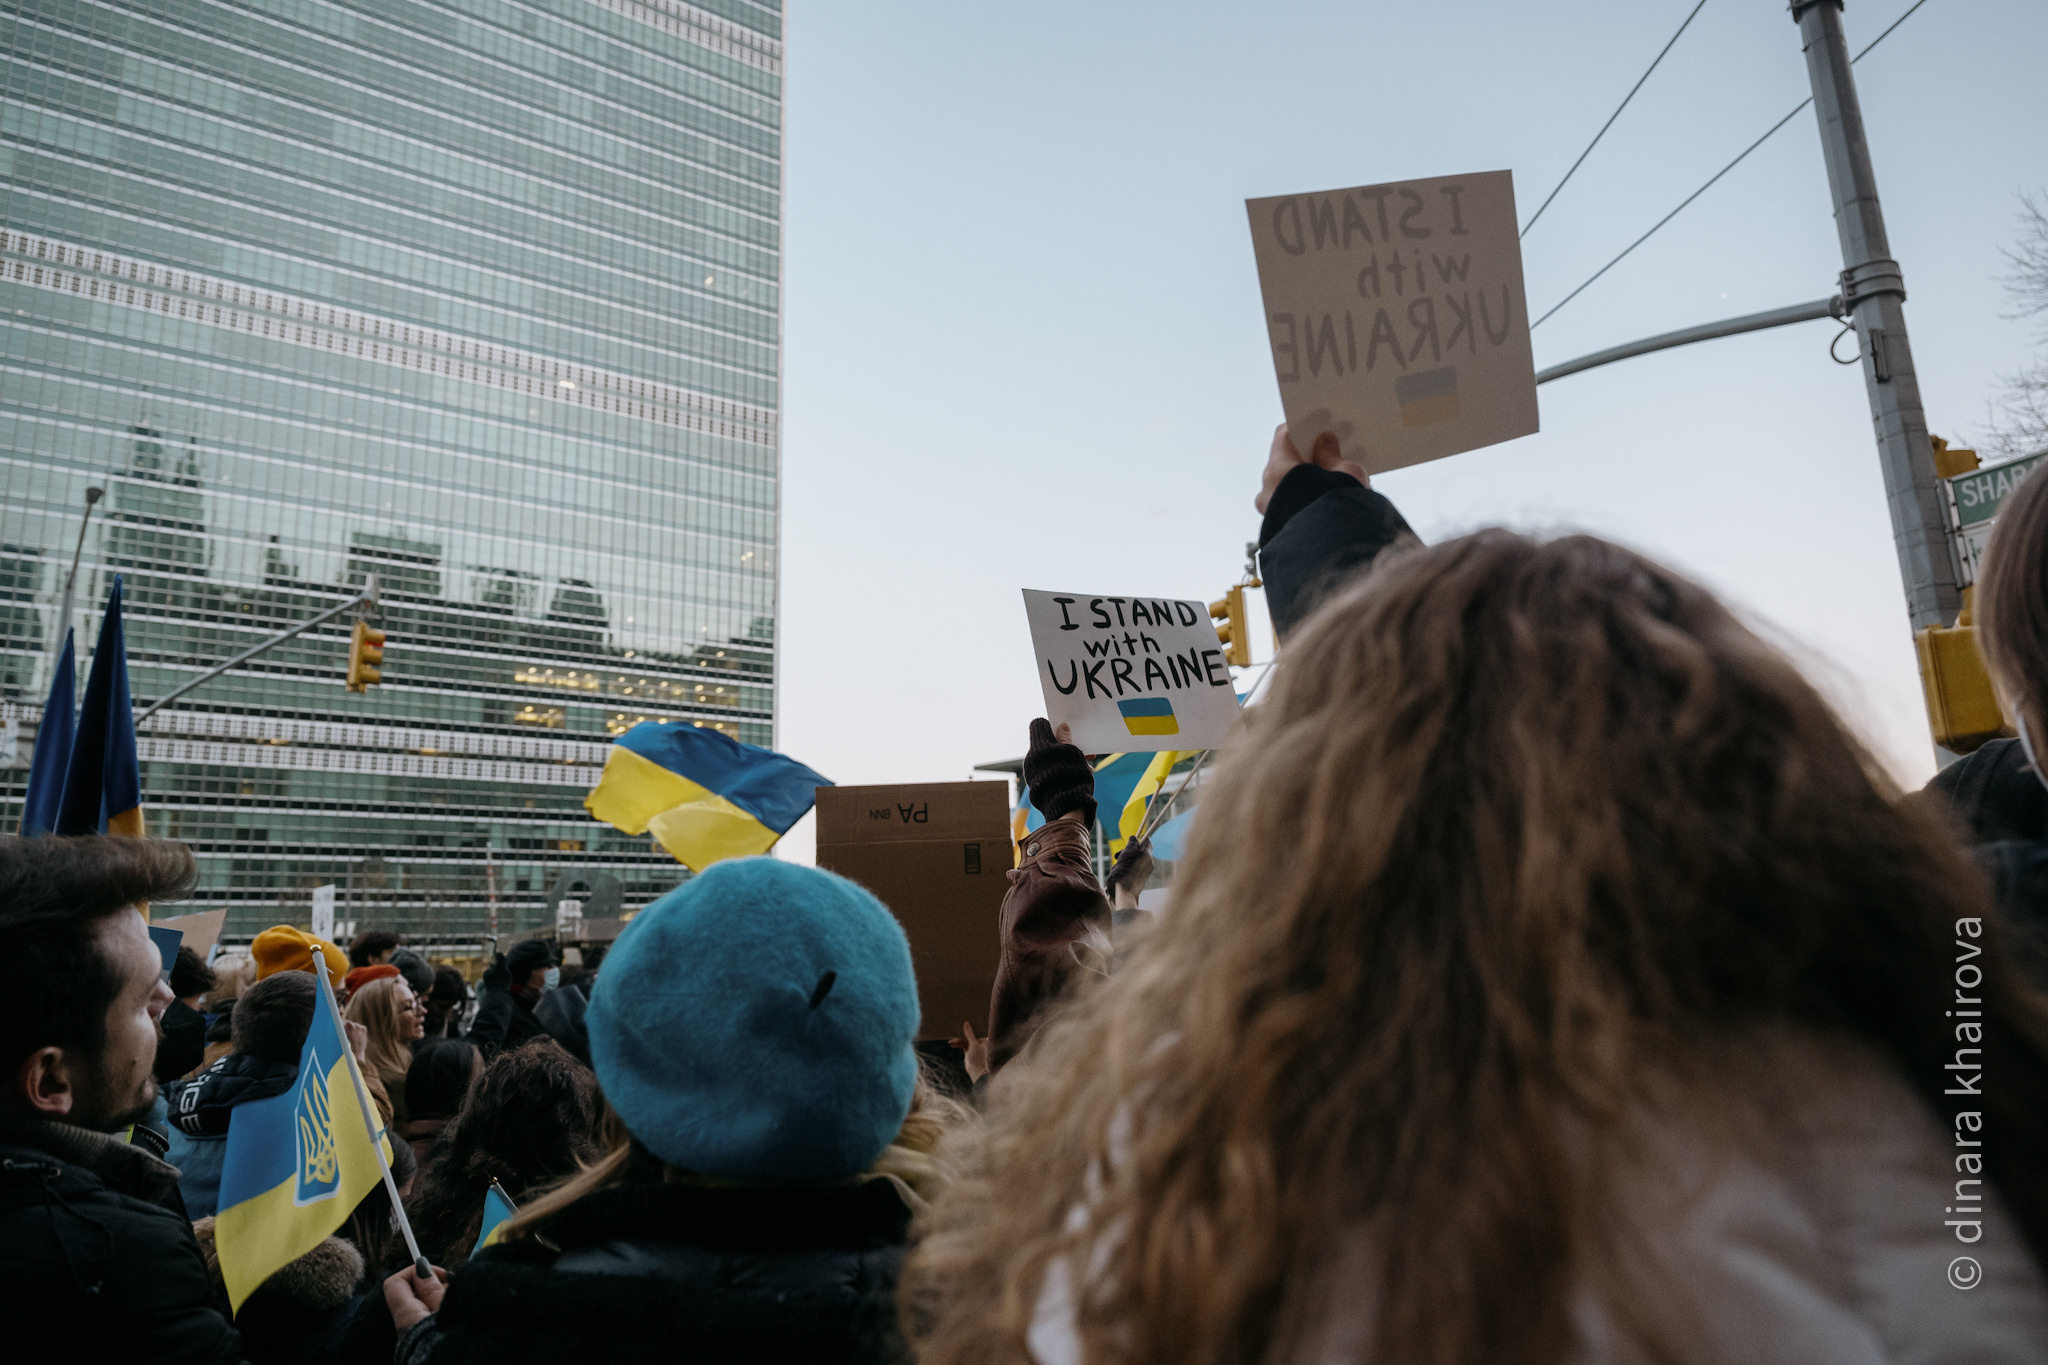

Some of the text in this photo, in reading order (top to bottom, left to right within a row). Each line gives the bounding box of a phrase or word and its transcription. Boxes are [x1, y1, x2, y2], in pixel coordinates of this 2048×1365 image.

[1961, 460, 2038, 507] SHAR
[1052, 597, 1198, 631] I STAND
[1083, 631, 1161, 658] with
[1047, 646, 1229, 700] UKRAINE
[897, 803, 929, 824] PA
